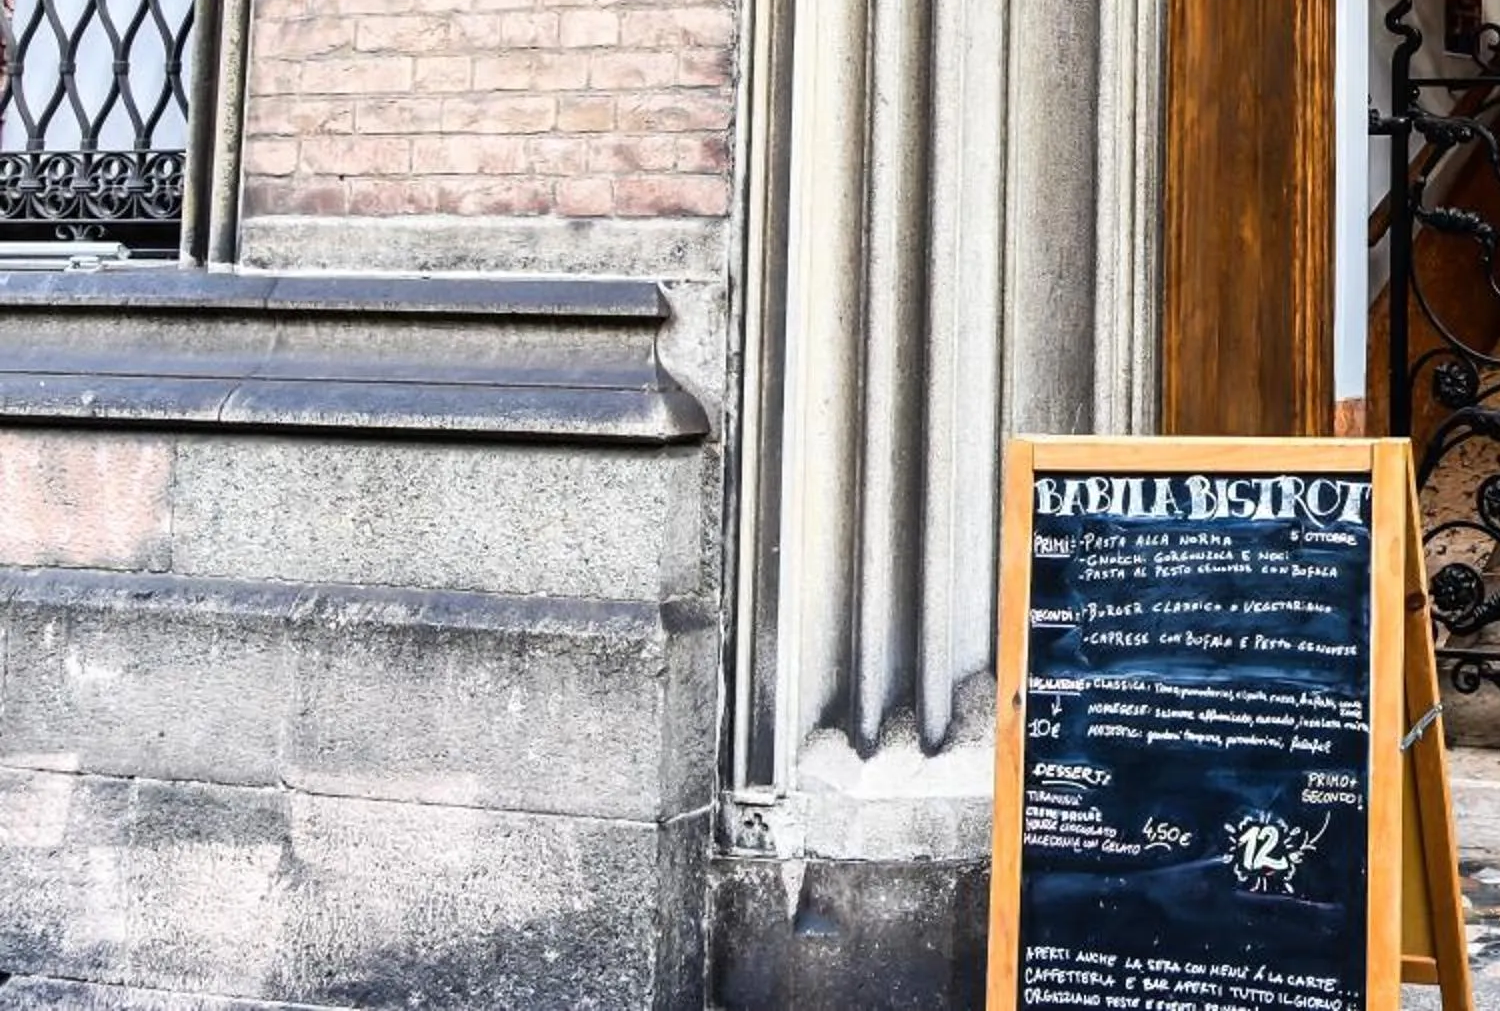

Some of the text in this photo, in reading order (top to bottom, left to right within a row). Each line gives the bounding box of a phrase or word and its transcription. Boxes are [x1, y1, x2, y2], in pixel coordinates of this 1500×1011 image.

[1034, 475, 1373, 528] BABILA BISTROT
[1179, 533, 1232, 546] NORMA
[1304, 532, 1358, 546] OTTOBRE
[1241, 550, 1250, 560] E
[1155, 565, 1191, 577] PESTO
[1239, 636, 1249, 649] E
[1254, 634, 1291, 649] PESTO
[1075, 951, 1118, 967] ANCHE
[1184, 962, 1207, 974] CON
[1268, 972, 1284, 984] LA
[1125, 977, 1136, 989] E
[1229, 987, 1275, 1004] TUTTO
